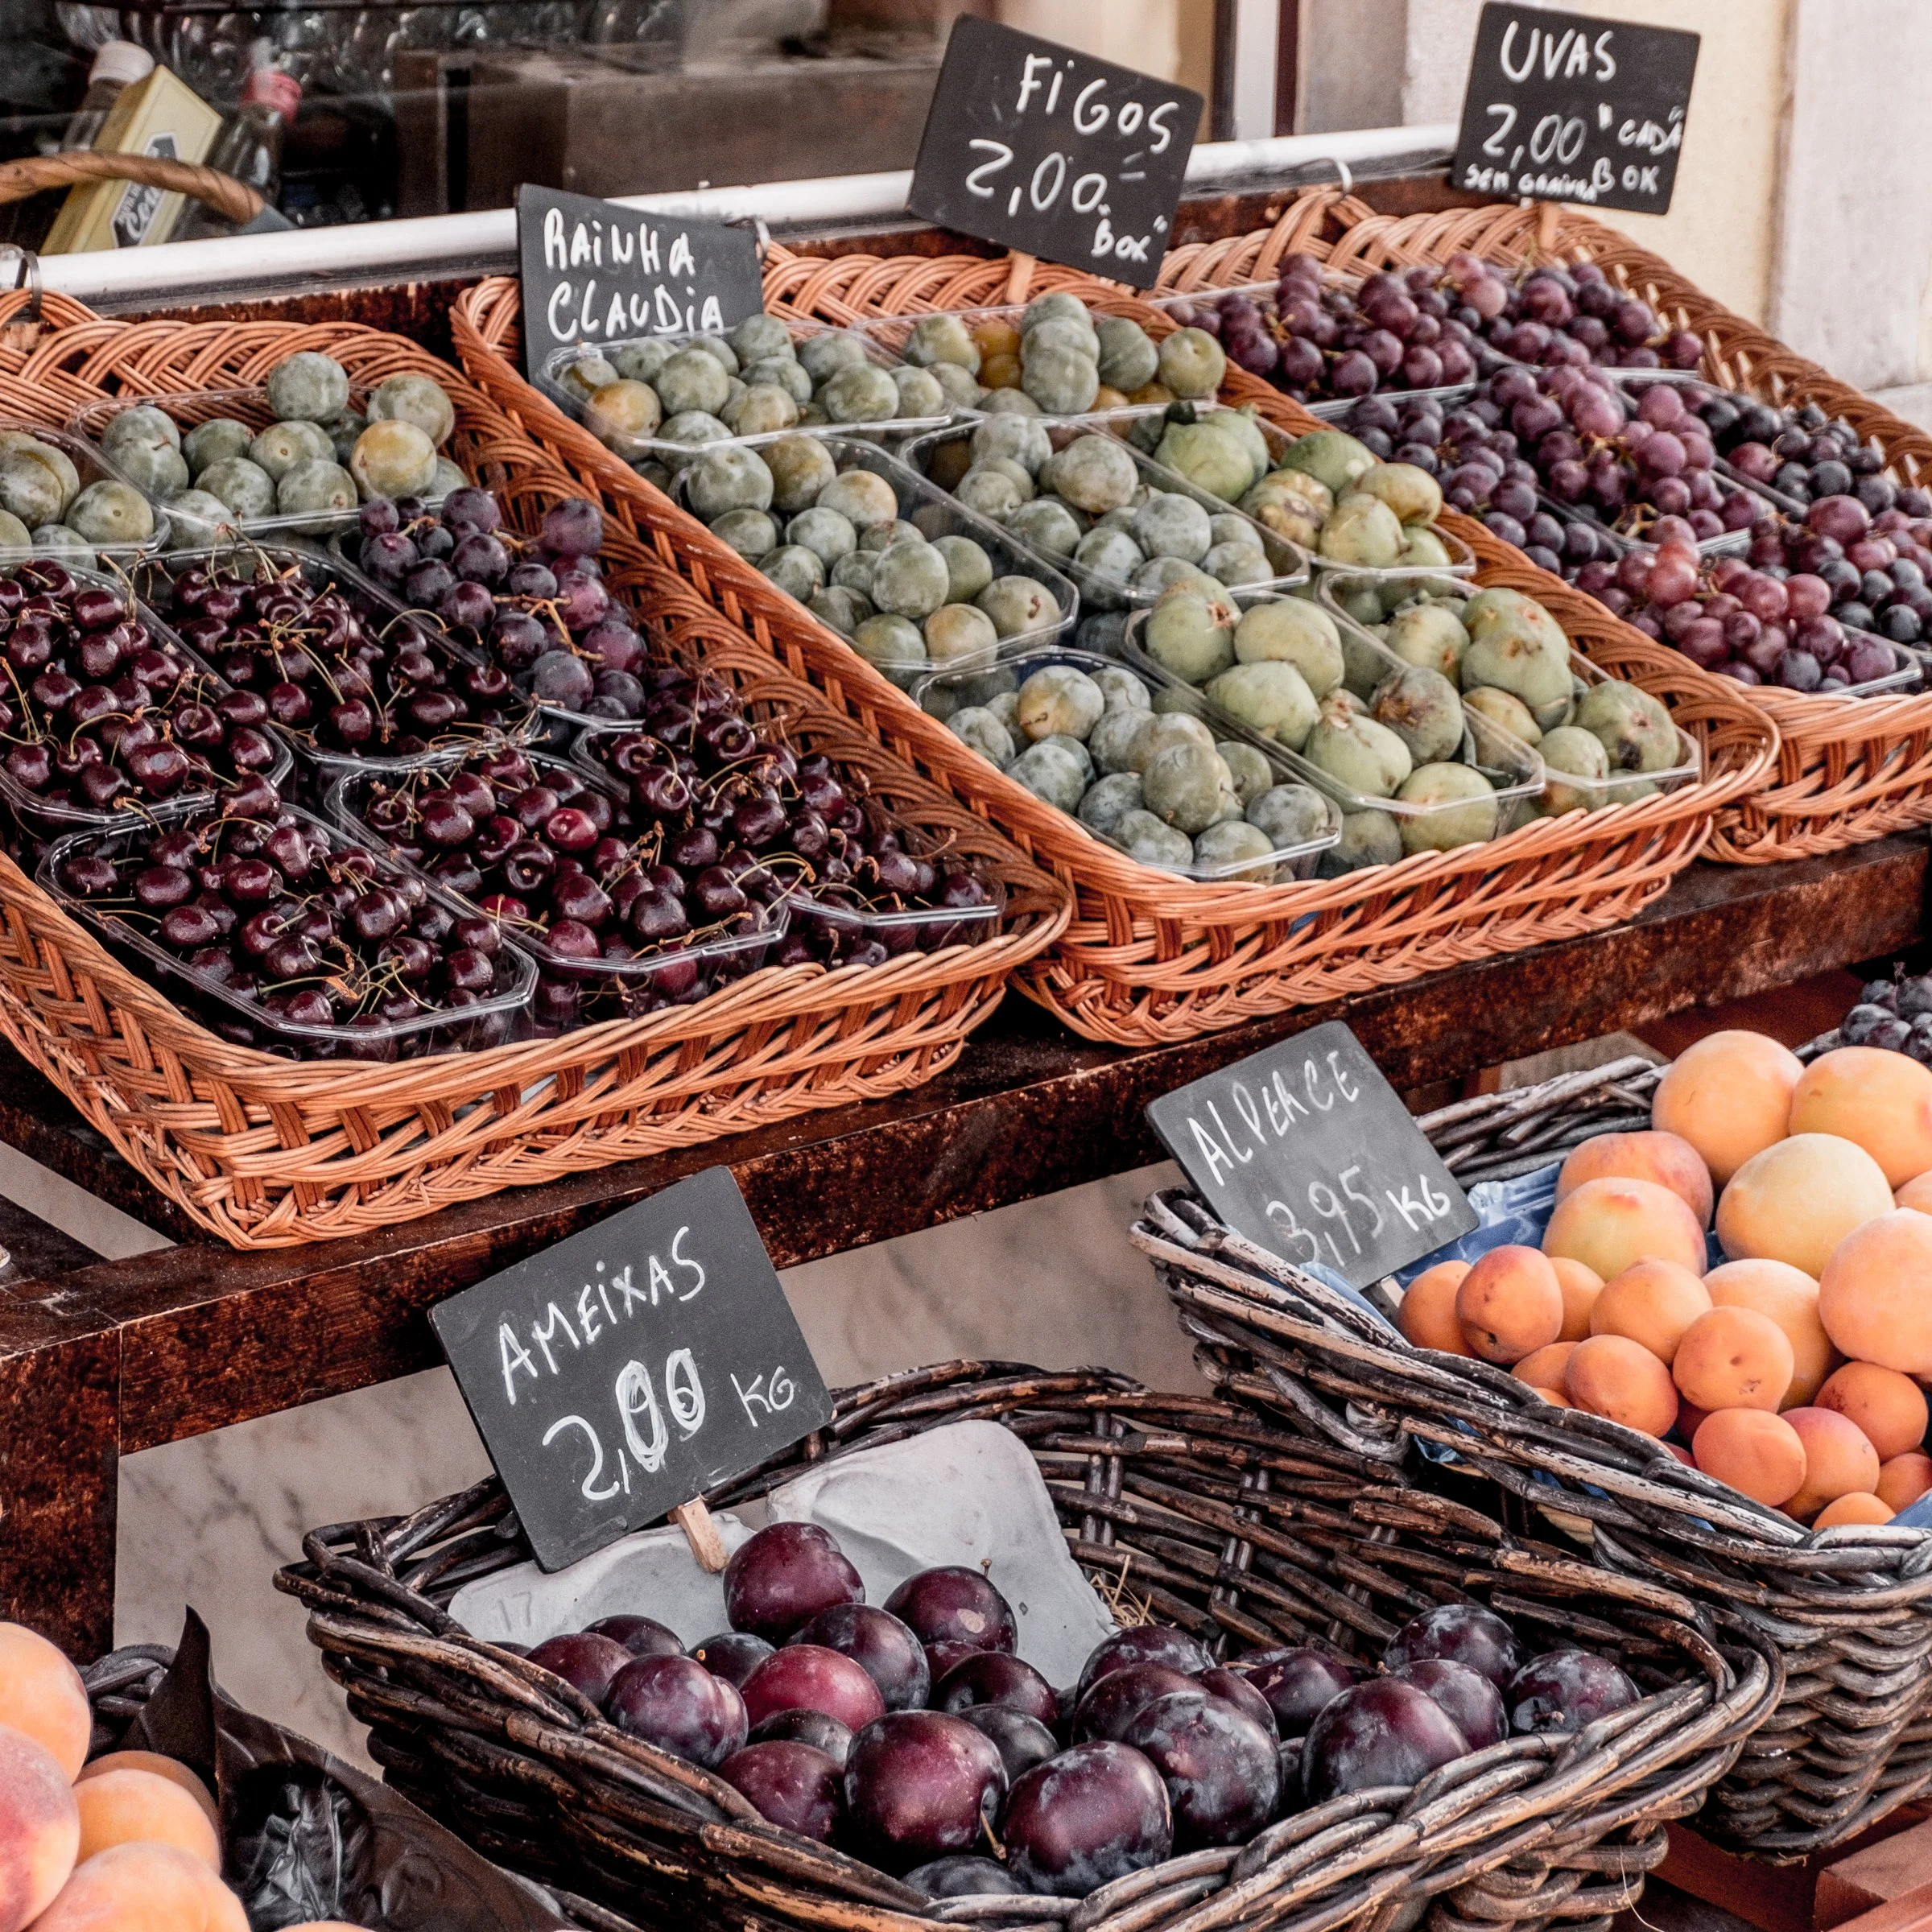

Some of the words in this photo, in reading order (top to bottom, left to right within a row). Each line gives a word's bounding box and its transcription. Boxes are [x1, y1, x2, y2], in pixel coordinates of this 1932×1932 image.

[1501, 21, 1616, 81] UVAS
[1482, 103, 1587, 170] 2,00
[965, 138, 1108, 217] 2,00
[1265, 1165, 1384, 1268] 3,95
[1385, 1174, 1451, 1232] KG
[542, 1348, 706, 1501] 2,00
[730, 1366, 795, 1426] KG
